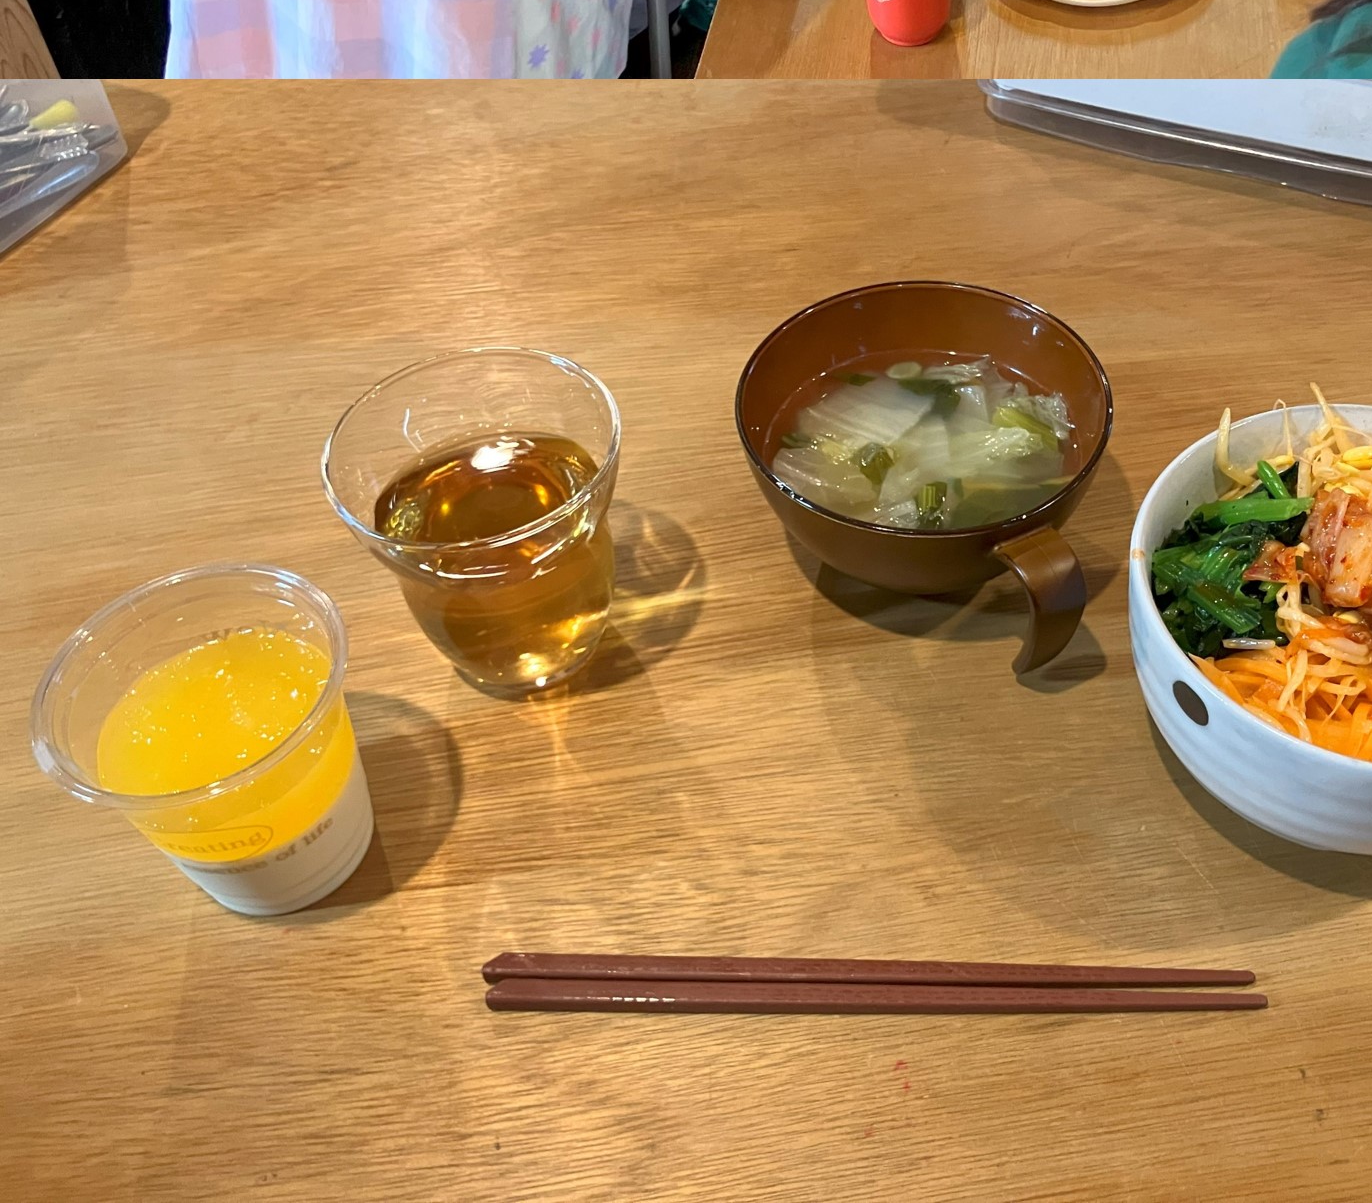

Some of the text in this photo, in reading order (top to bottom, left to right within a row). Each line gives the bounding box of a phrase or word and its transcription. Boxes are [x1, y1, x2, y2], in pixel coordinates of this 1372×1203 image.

[161, 831, 268, 854] reating
[275, 842, 297, 861] of
[302, 817, 334, 846] life
